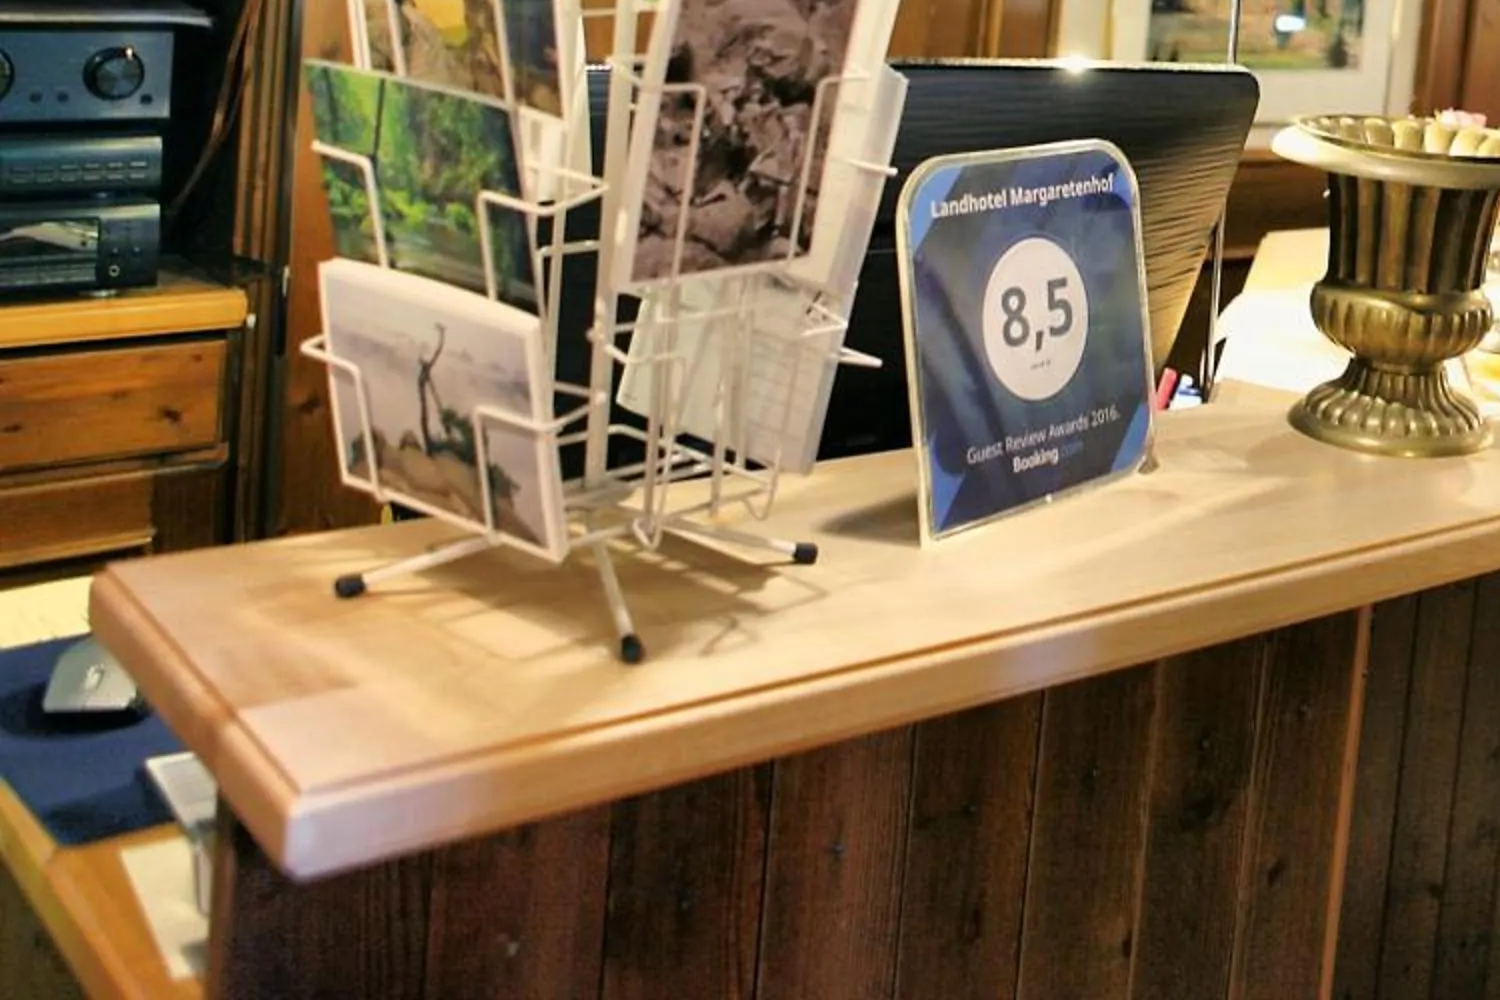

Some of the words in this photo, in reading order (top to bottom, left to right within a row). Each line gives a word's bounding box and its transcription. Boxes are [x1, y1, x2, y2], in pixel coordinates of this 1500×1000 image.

[930, 189, 1007, 218] Landhotel
[1010, 173, 1115, 207] Margaretenhof
[1000, 277, 1073, 351] 8,5
[966, 441, 1003, 464] Guest
[1005, 427, 1047, 453] Review
[1049, 413, 1089, 437] Awards
